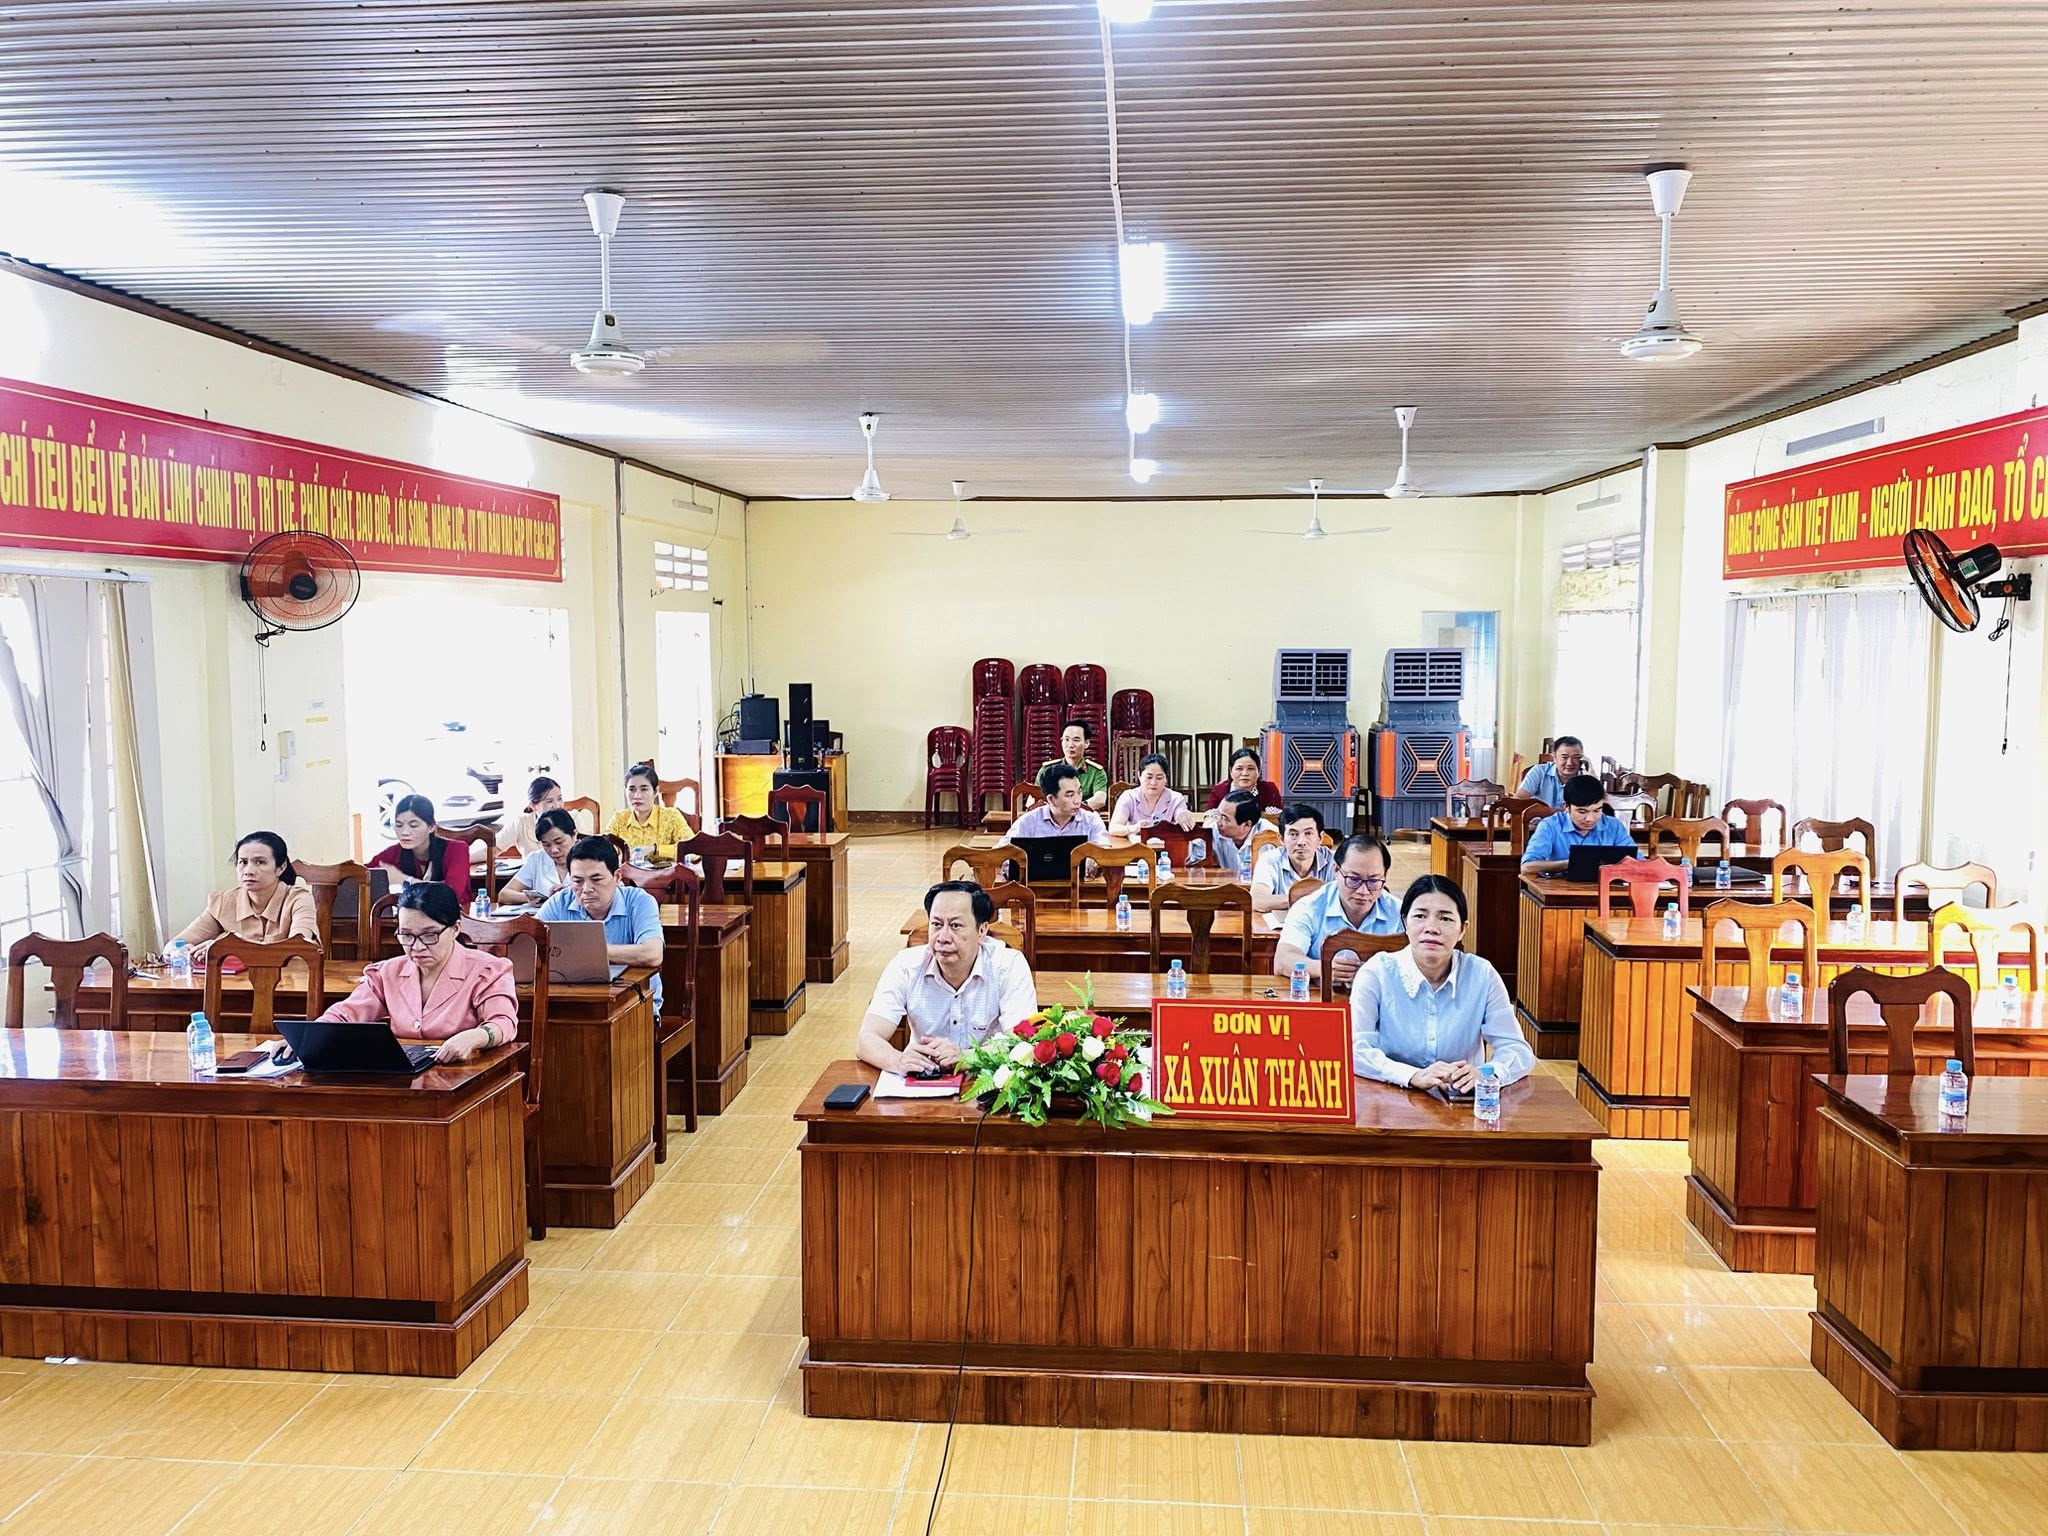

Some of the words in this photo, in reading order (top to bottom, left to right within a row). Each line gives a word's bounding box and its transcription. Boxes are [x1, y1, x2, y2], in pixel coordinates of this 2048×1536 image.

[0, 420, 29, 507] CHÍ
[31, 424, 67, 512] TIÊU
[71, 418, 106, 515] BIỂU
[109, 430, 128, 518] VỀ
[130, 433, 160, 521] BẢN
[163, 447, 192, 524] LĨNH
[195, 455, 232, 529] CHÍNH
[234, 472, 256, 544] TRỊ,
[257, 465, 274, 533] TRÍ
[300, 462, 328, 536] PHẨM
[330, 470, 355, 547] CHẤT,
[355, 491, 373, 553] ĐẠO
[374, 484, 394, 551] ĐỨC,
[395, 480, 408, 546] LỐI
[408, 483, 431, 554] SỐNG,
[431, 494, 451, 551] NĂNG
[467, 508, 476, 552] UY
[477, 500, 488, 553] TÍN
[1728, 499, 1752, 556] ĐẢNG
[1754, 499, 1779, 562] CỘNG
[1781, 487, 1803, 550] SẢN
[1804, 488, 1829, 557] VIỆT
[1830, 490, 1860, 544] NAM
[1861, 512, 1867, 523] -
[1869, 467, 1912, 539] NGƯỜI
[1914, 464, 1957, 532] LÃNH
[1958, 463, 1997, 540] ĐẠO,
[2003, 432, 2029, 523] TỔ
[1164, 1040, 1194, 1104] XÃ
[1199, 1043, 1259, 1106] XUÂN
[1264, 1043, 1343, 1109] THÀNH
[1213, 1011, 1261, 1035] ĐƠN
[1268, 1014, 1290, 1040] VỊ
